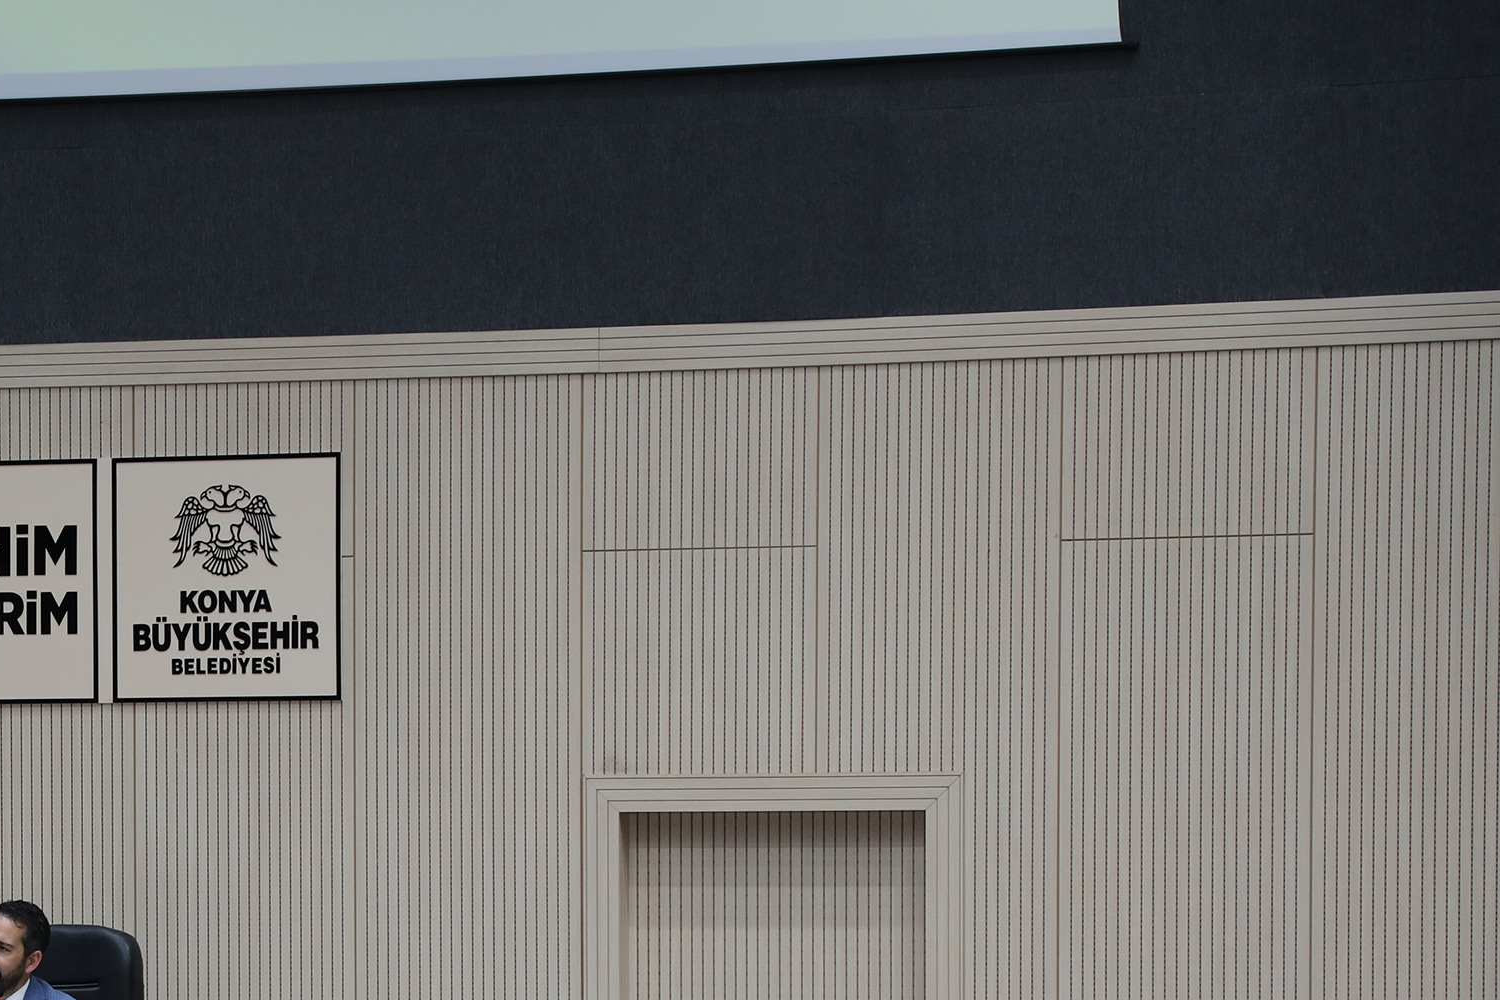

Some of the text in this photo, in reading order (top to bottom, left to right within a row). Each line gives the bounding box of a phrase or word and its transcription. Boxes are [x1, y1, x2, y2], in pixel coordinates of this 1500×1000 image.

[179, 589, 273, 614] KONYA
[132, 614, 320, 655] BÜYÜKŞEHİR
[171, 652, 281, 675] BELEDİYESİ
